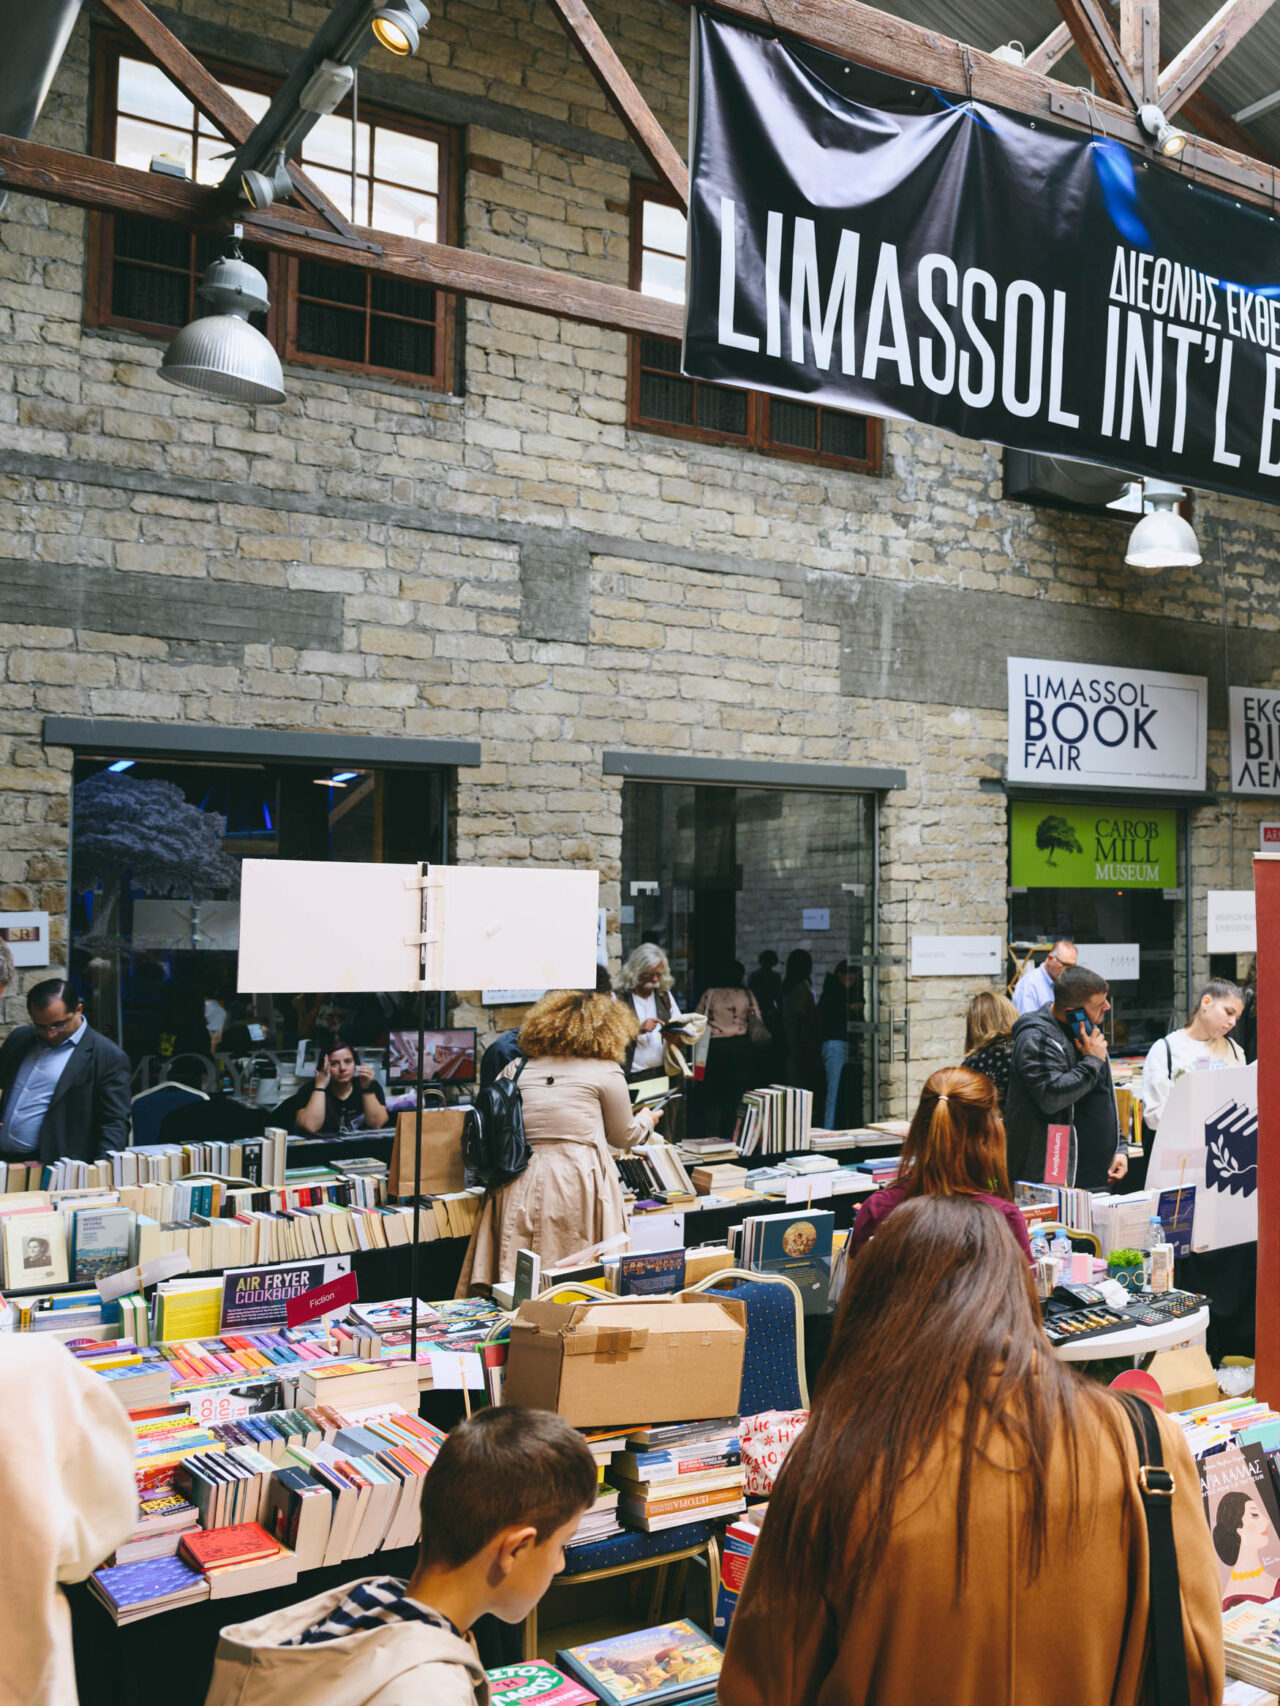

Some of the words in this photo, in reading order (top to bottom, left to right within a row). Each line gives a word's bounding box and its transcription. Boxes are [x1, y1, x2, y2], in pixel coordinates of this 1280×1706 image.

[1109, 245, 1222, 331] ΔΙΕΘΝΗΣ
[718, 197, 1081, 429] LIMASSOL
[1101, 304, 1241, 468] INT'L
[1024, 674, 1150, 707] LIMASSOL
[1025, 699, 1158, 750] BOOK
[1024, 742, 1081, 771] FAIR
[1094, 818, 1159, 840] CAROB
[1094, 838, 1159, 863] MILL
[1095, 863, 1160, 882] MUSEUM
[236, 1276, 261, 1293] AIR
[264, 1270, 310, 1290] FRYER
[235, 1285, 309, 1305] COOKBOOK
[309, 1292, 335, 1309] Fiction
[673, 1494, 709, 1510] ΙΣΤΟΡΙΑ
[487, 1666, 538, 1681] ΣΤΟ
